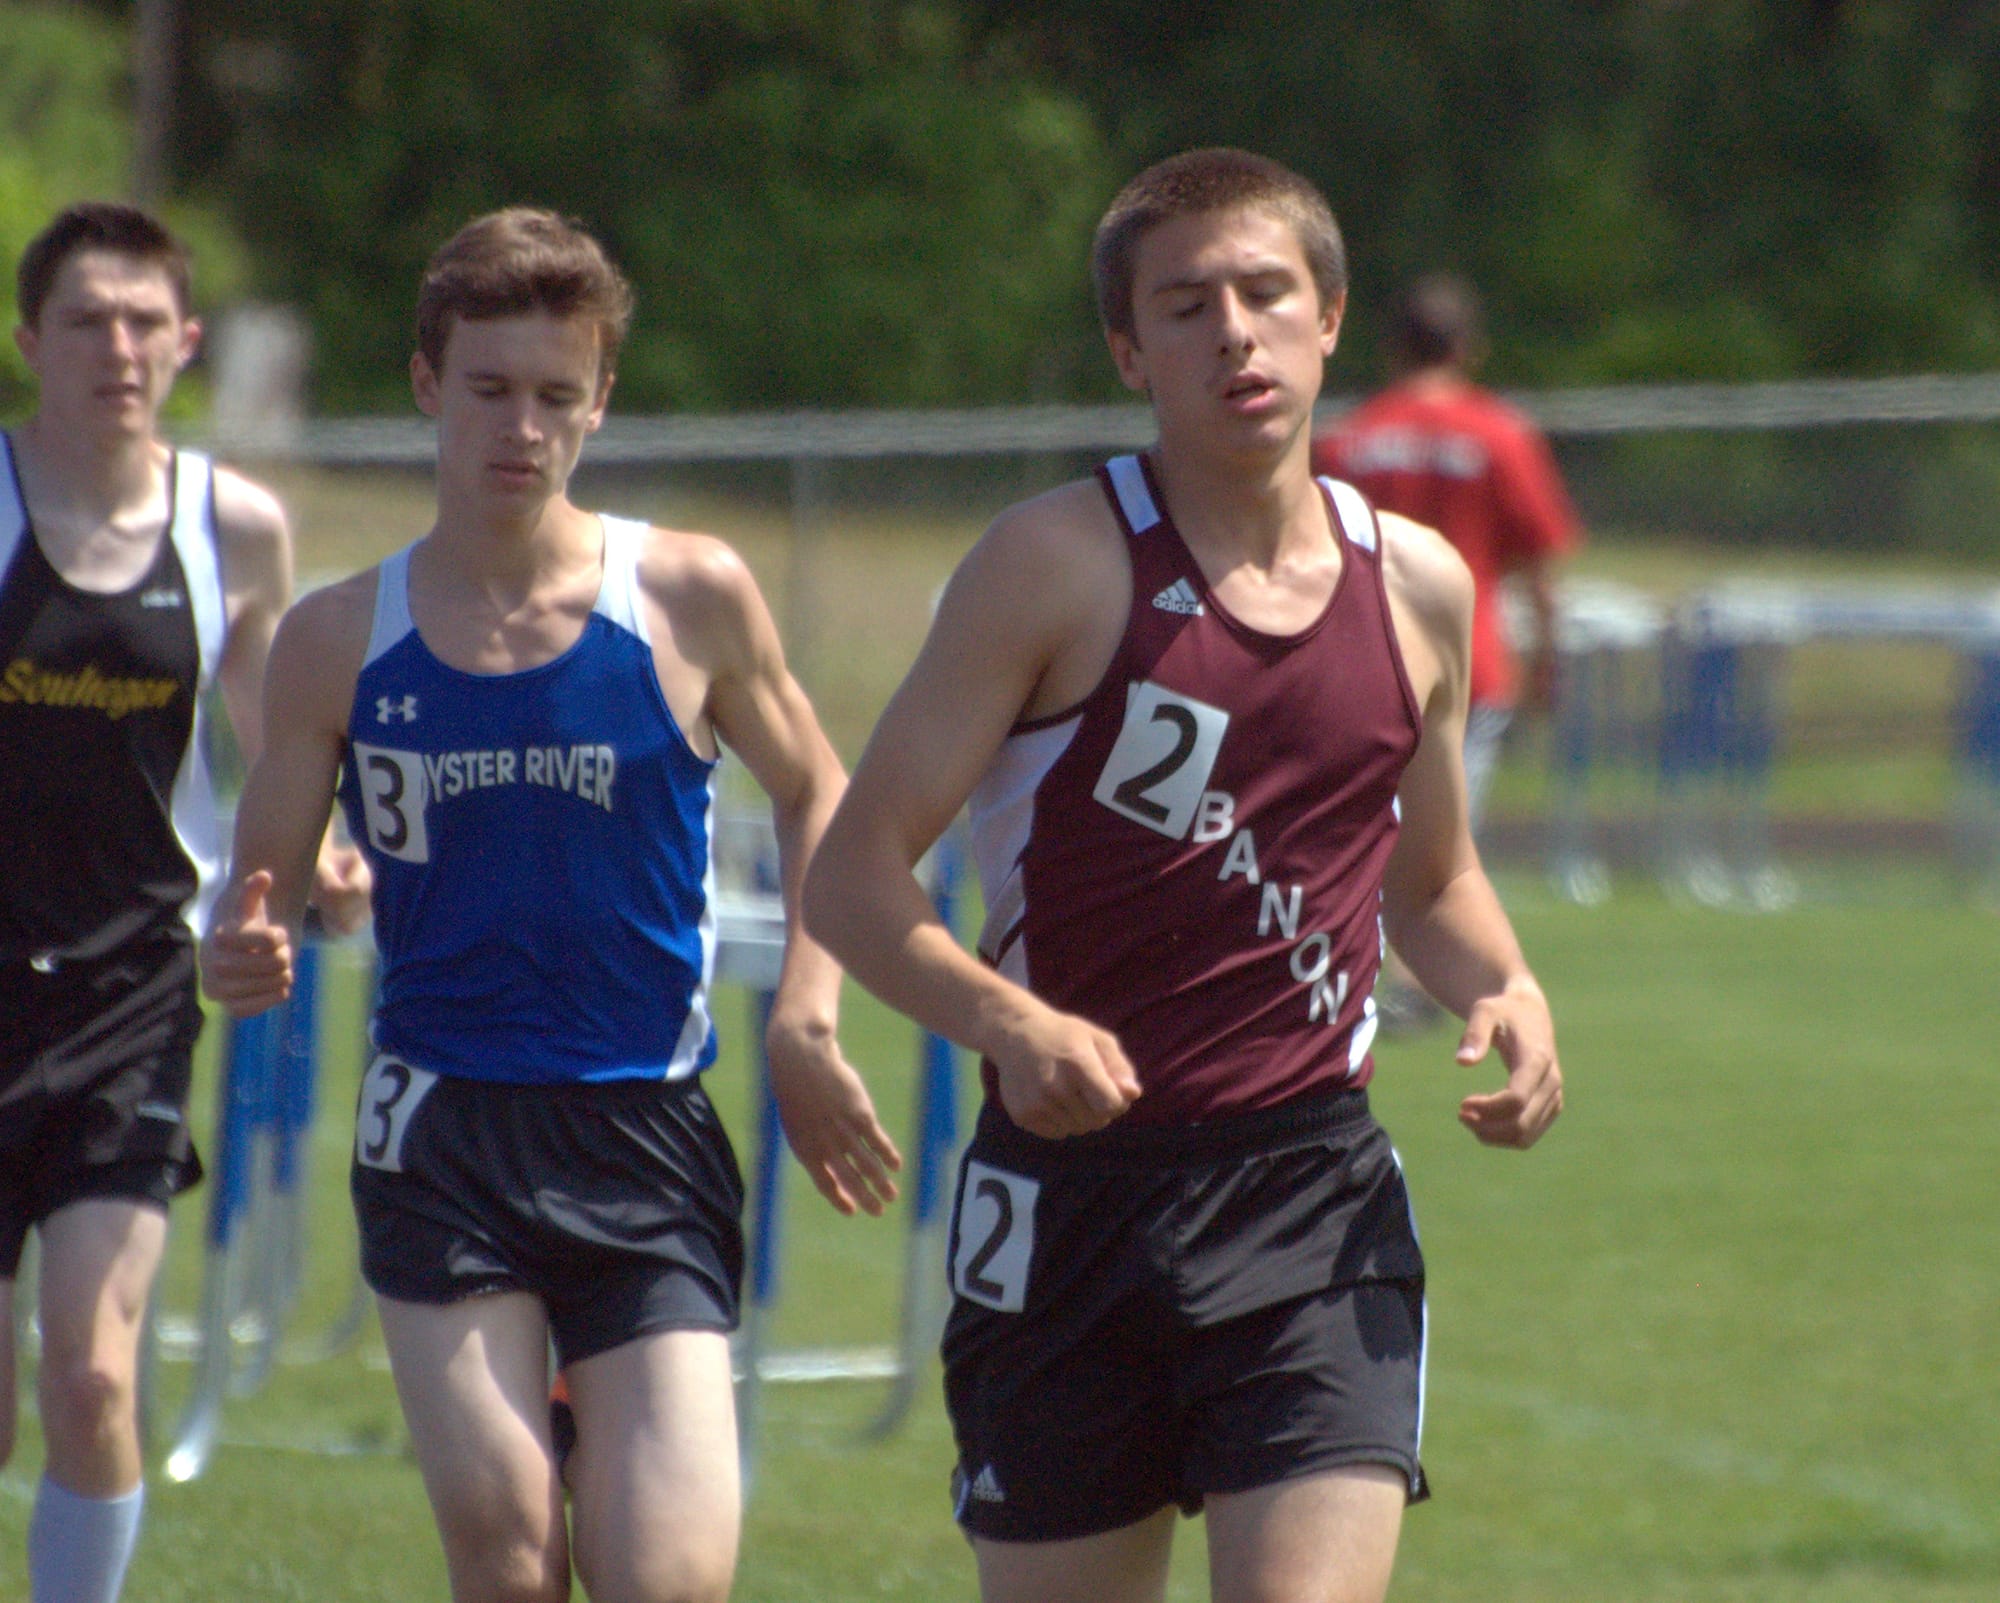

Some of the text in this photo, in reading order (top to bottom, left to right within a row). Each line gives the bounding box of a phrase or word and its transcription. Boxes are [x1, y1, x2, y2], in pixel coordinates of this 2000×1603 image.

[367, 755, 408, 852] 3
[419, 745, 615, 813] YSTER RIVER
[1112, 703, 1199, 827] 2
[363, 1062, 411, 1162] 3
[963, 1178, 1013, 1304] 2
